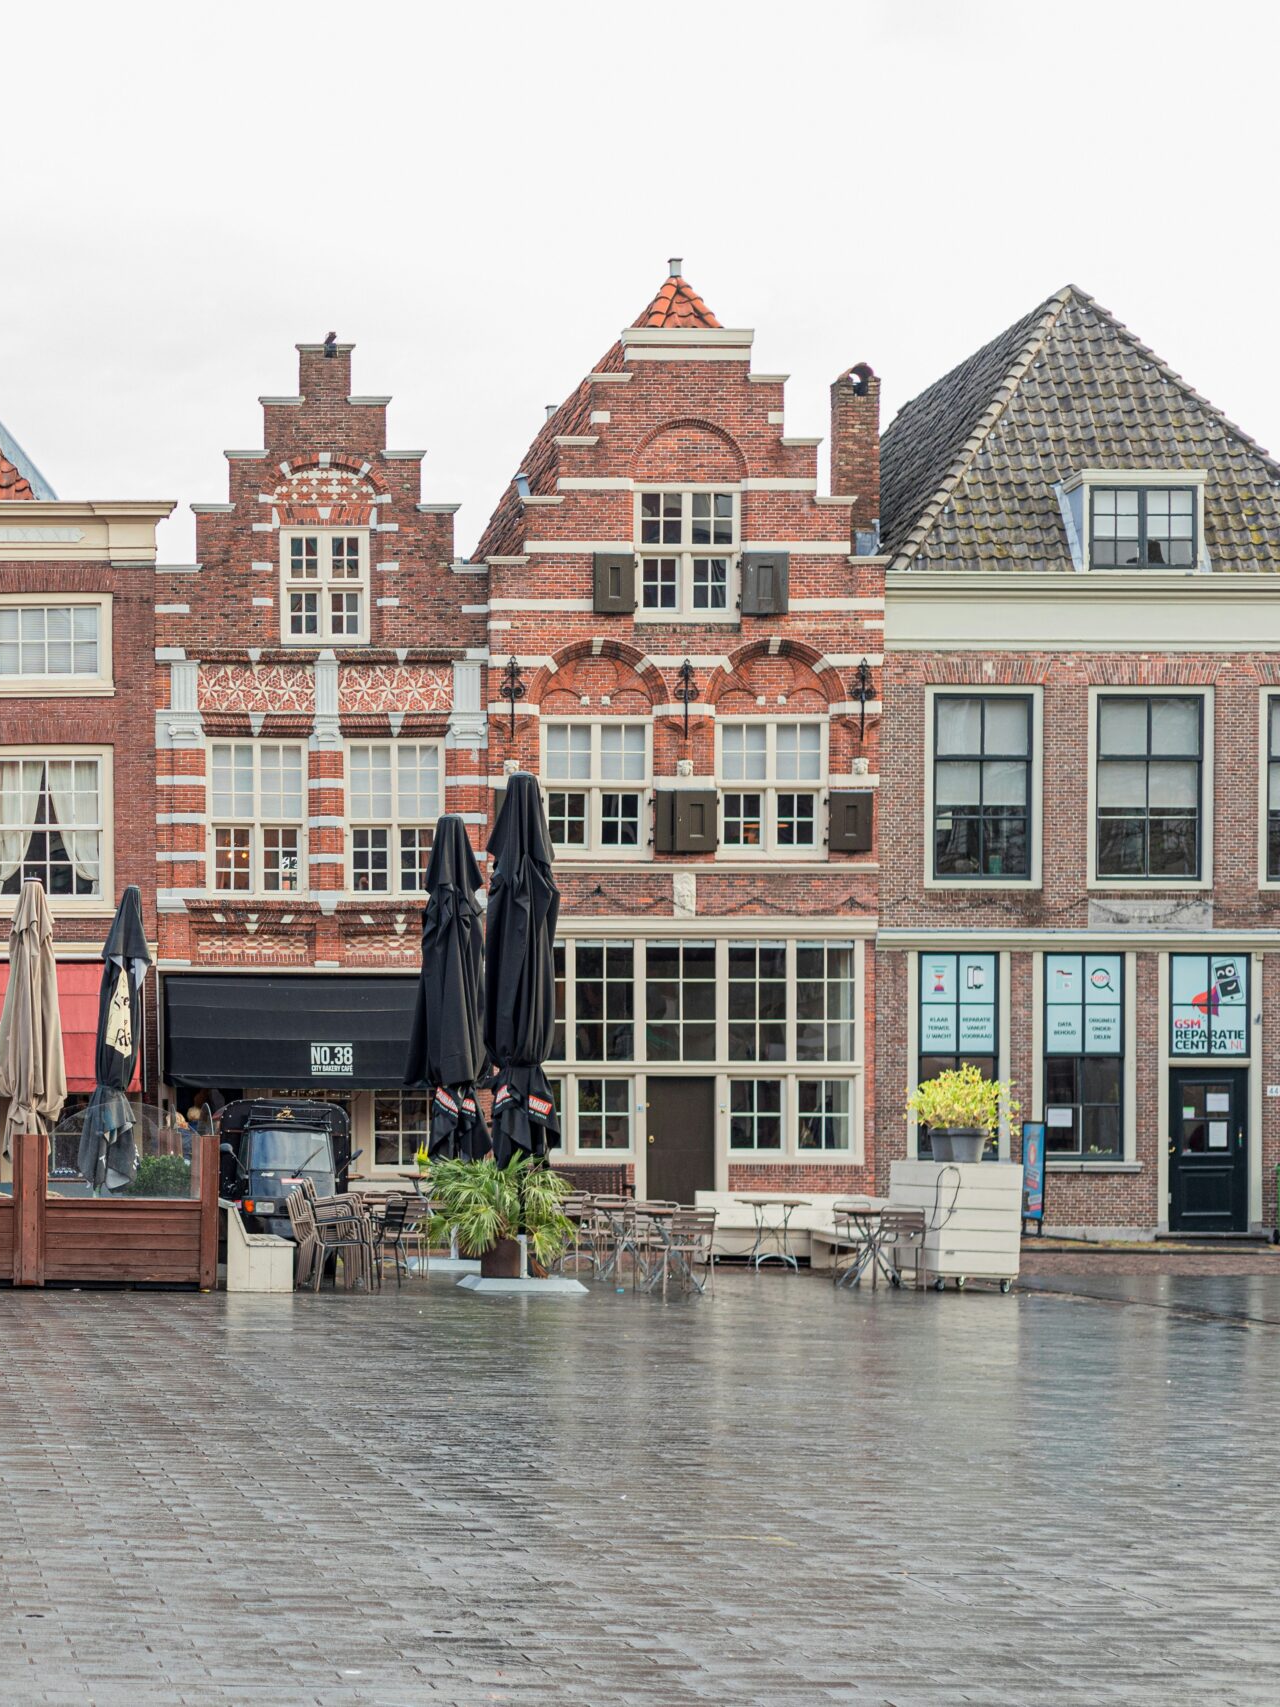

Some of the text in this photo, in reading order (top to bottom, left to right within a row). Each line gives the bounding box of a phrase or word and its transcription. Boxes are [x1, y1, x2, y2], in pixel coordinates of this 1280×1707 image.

[1174, 1019, 1201, 1029] GSM
[1175, 1029, 1245, 1039] REPARATIE
[1175, 1040, 1227, 1050] CENTRA
[310, 1046, 353, 1065] NO.38
